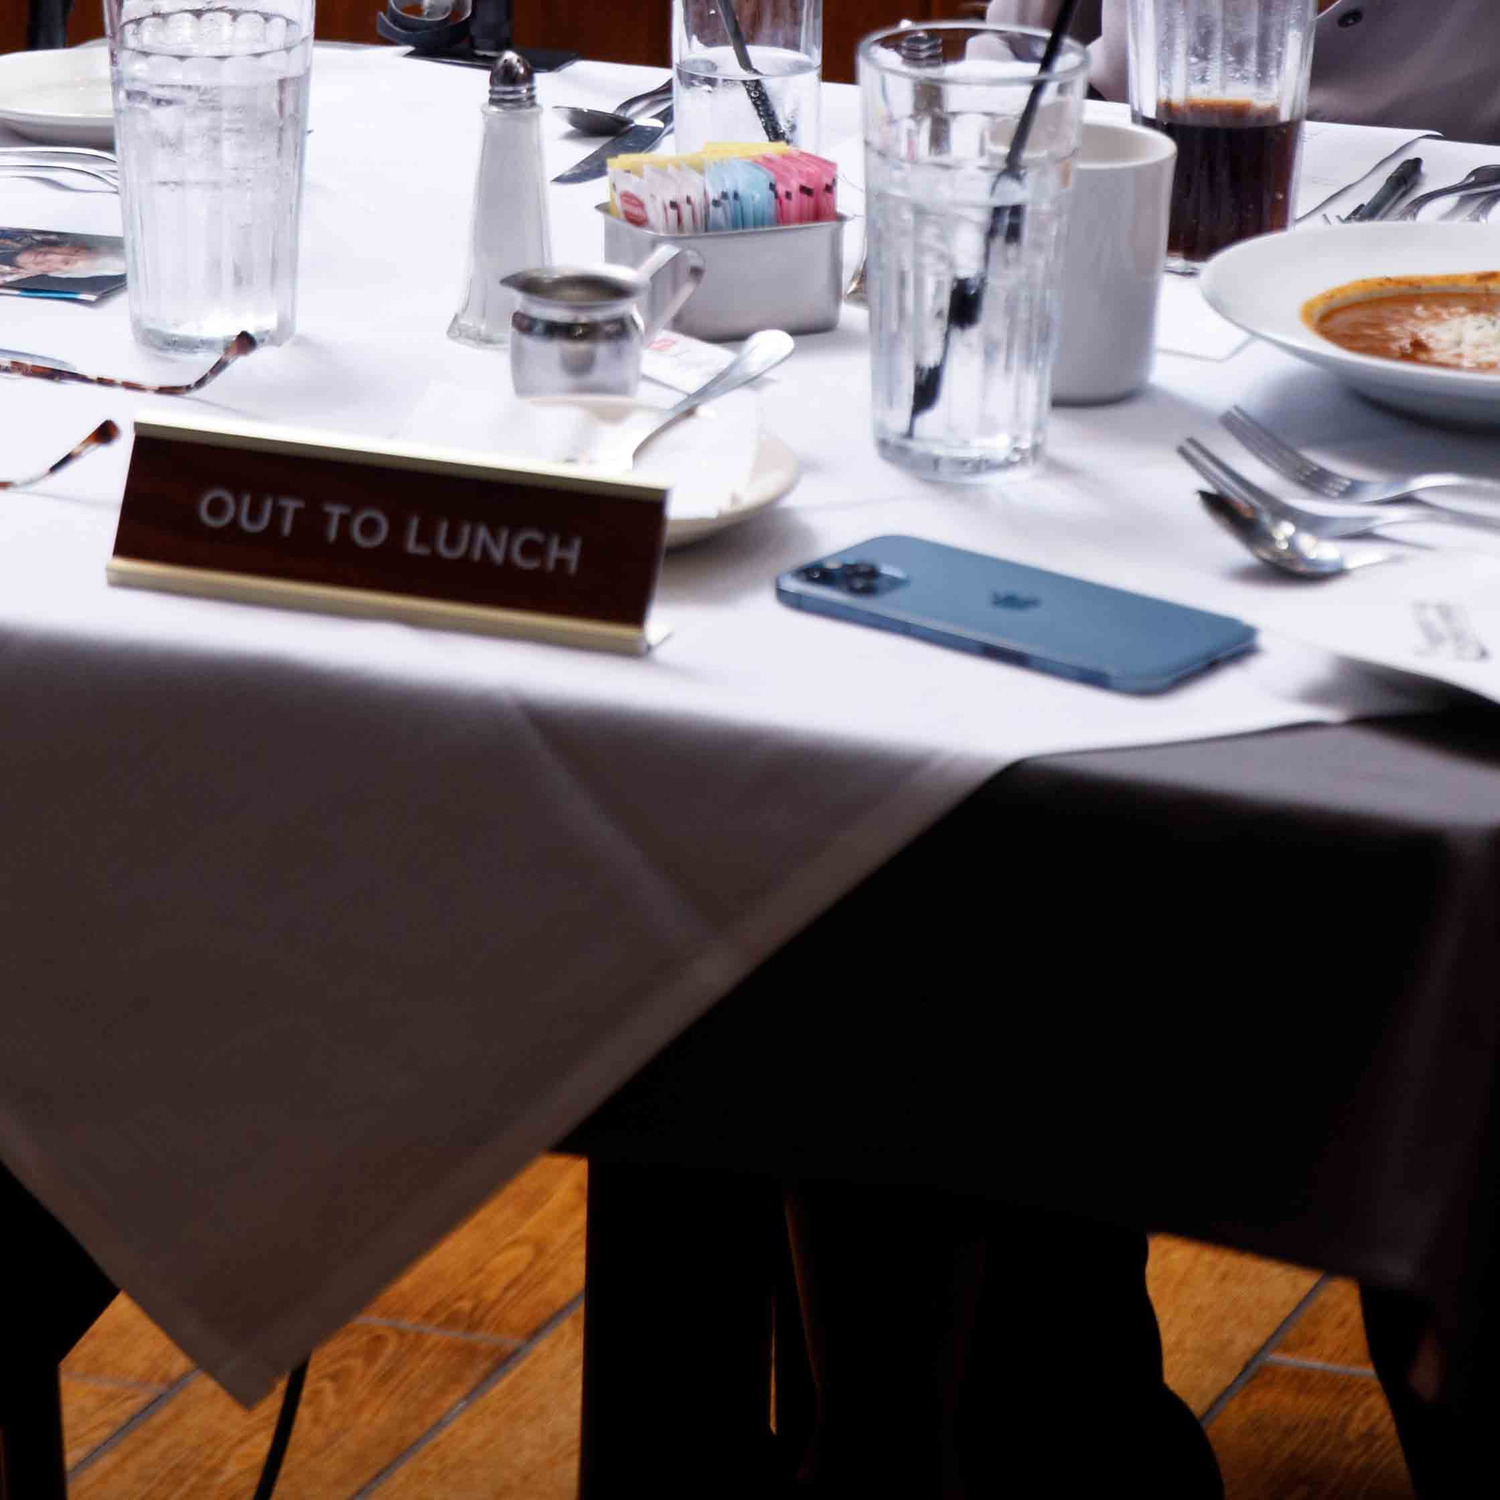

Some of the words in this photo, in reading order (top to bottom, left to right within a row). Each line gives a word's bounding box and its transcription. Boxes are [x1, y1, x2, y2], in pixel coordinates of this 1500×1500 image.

[199, 488, 305, 537] OUT
[323, 503, 389, 549] TO
[406, 515, 582, 576] LUNCH
